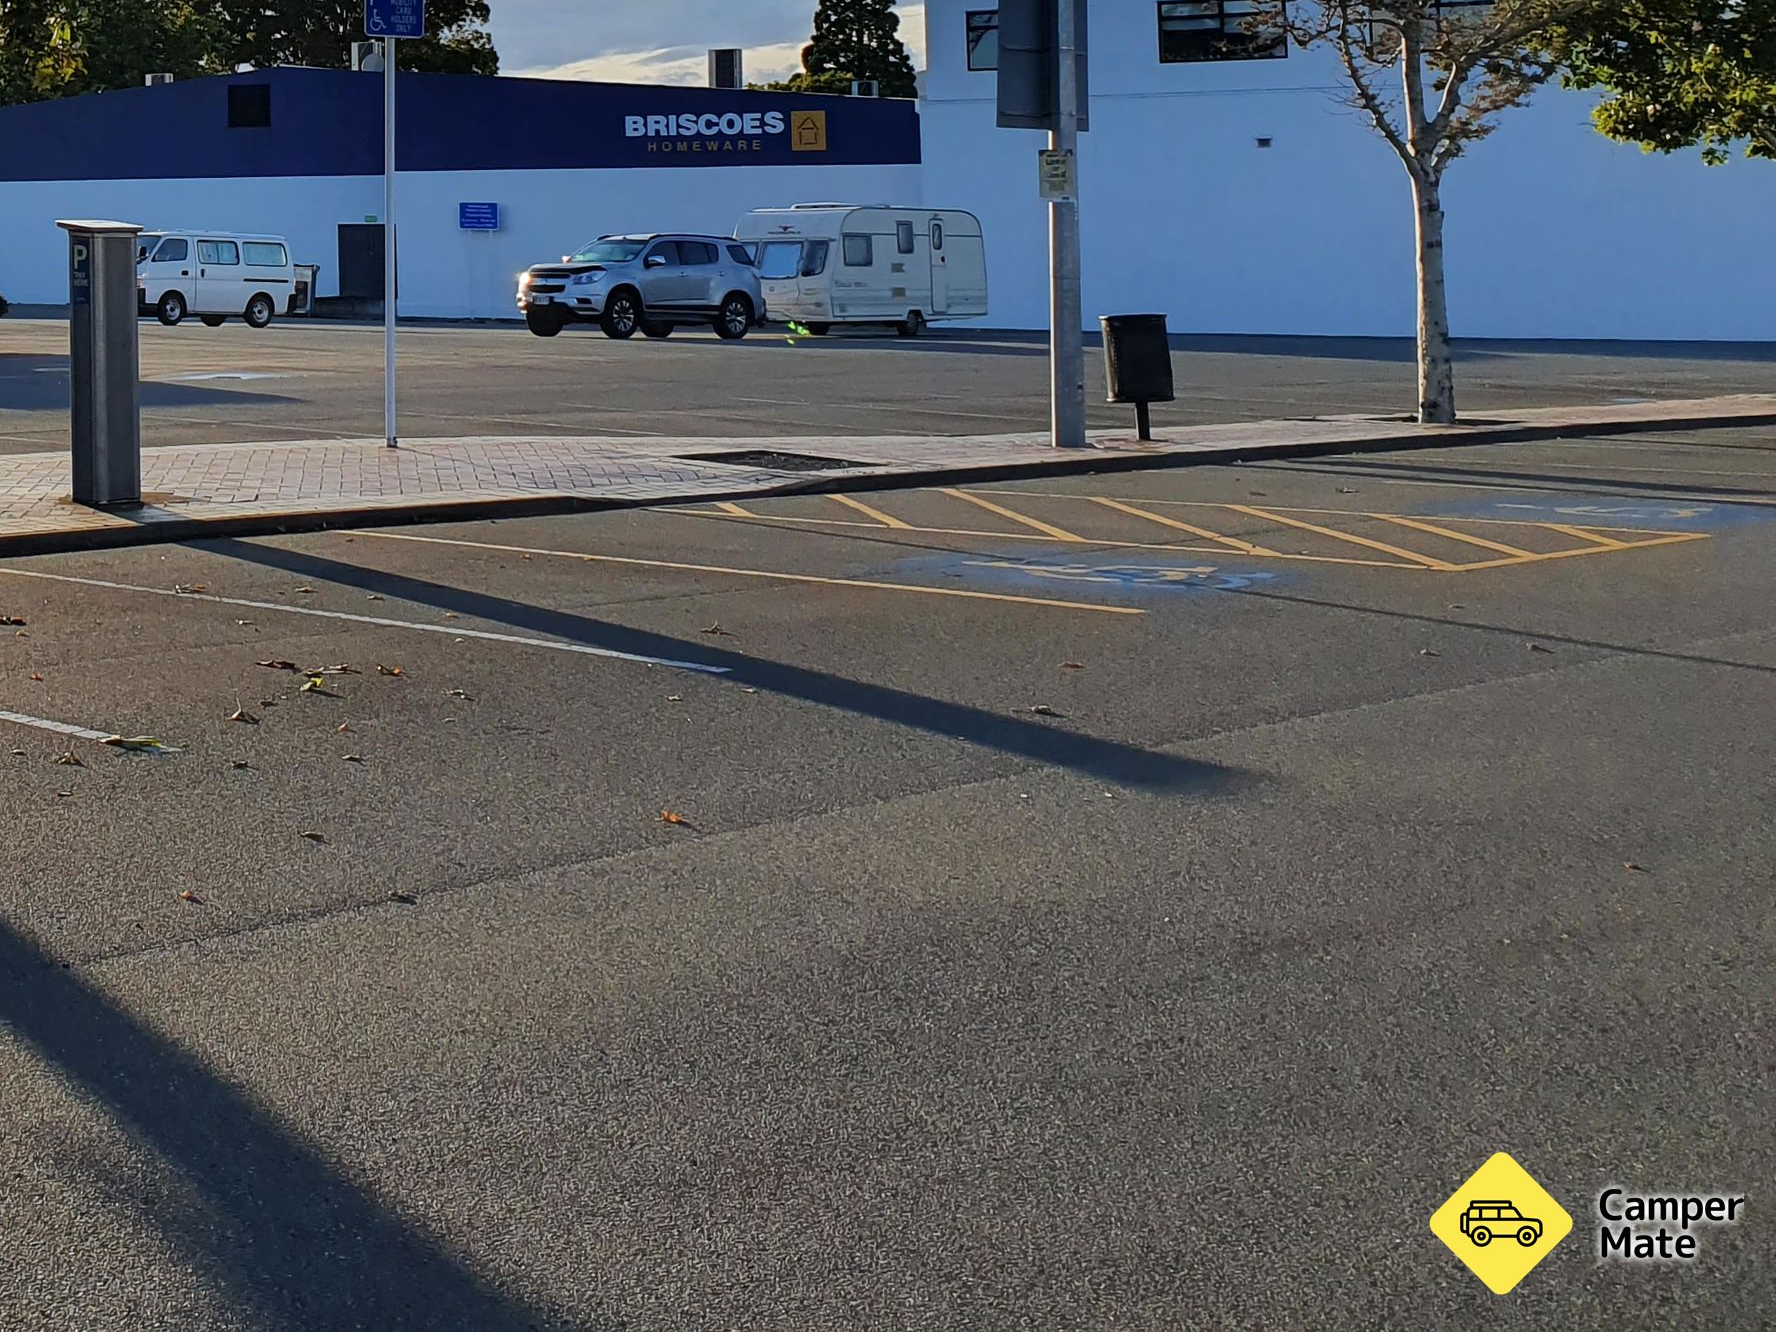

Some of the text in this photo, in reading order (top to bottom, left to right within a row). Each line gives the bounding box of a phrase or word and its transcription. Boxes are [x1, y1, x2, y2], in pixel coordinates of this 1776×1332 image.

[625, 111, 784, 137] BRISCOES
[647, 139, 761, 152] HOMEWARE
[73, 244, 88, 270] P
